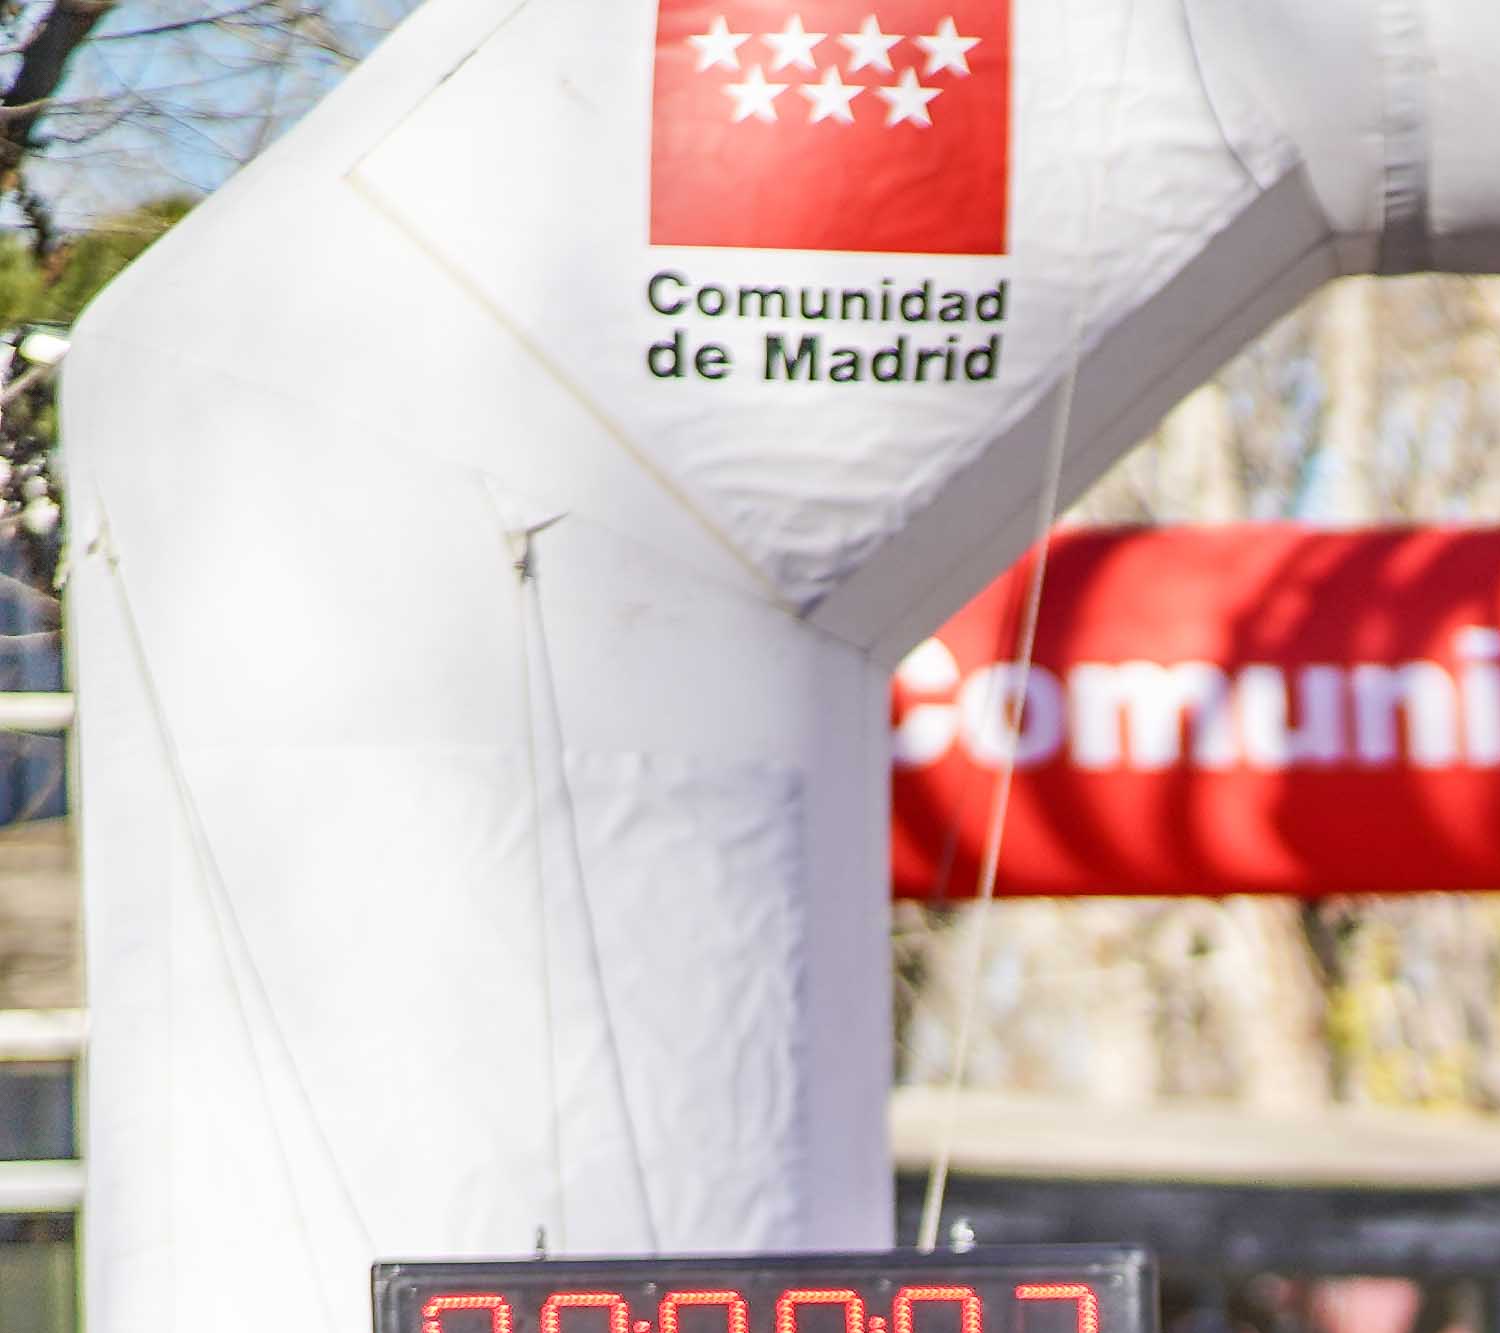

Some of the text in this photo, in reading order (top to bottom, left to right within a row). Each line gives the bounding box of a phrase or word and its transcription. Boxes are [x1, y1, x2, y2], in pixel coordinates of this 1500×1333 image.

[646, 268, 1010, 322] Comunidad
[646, 328, 1001, 383] de Madrid
